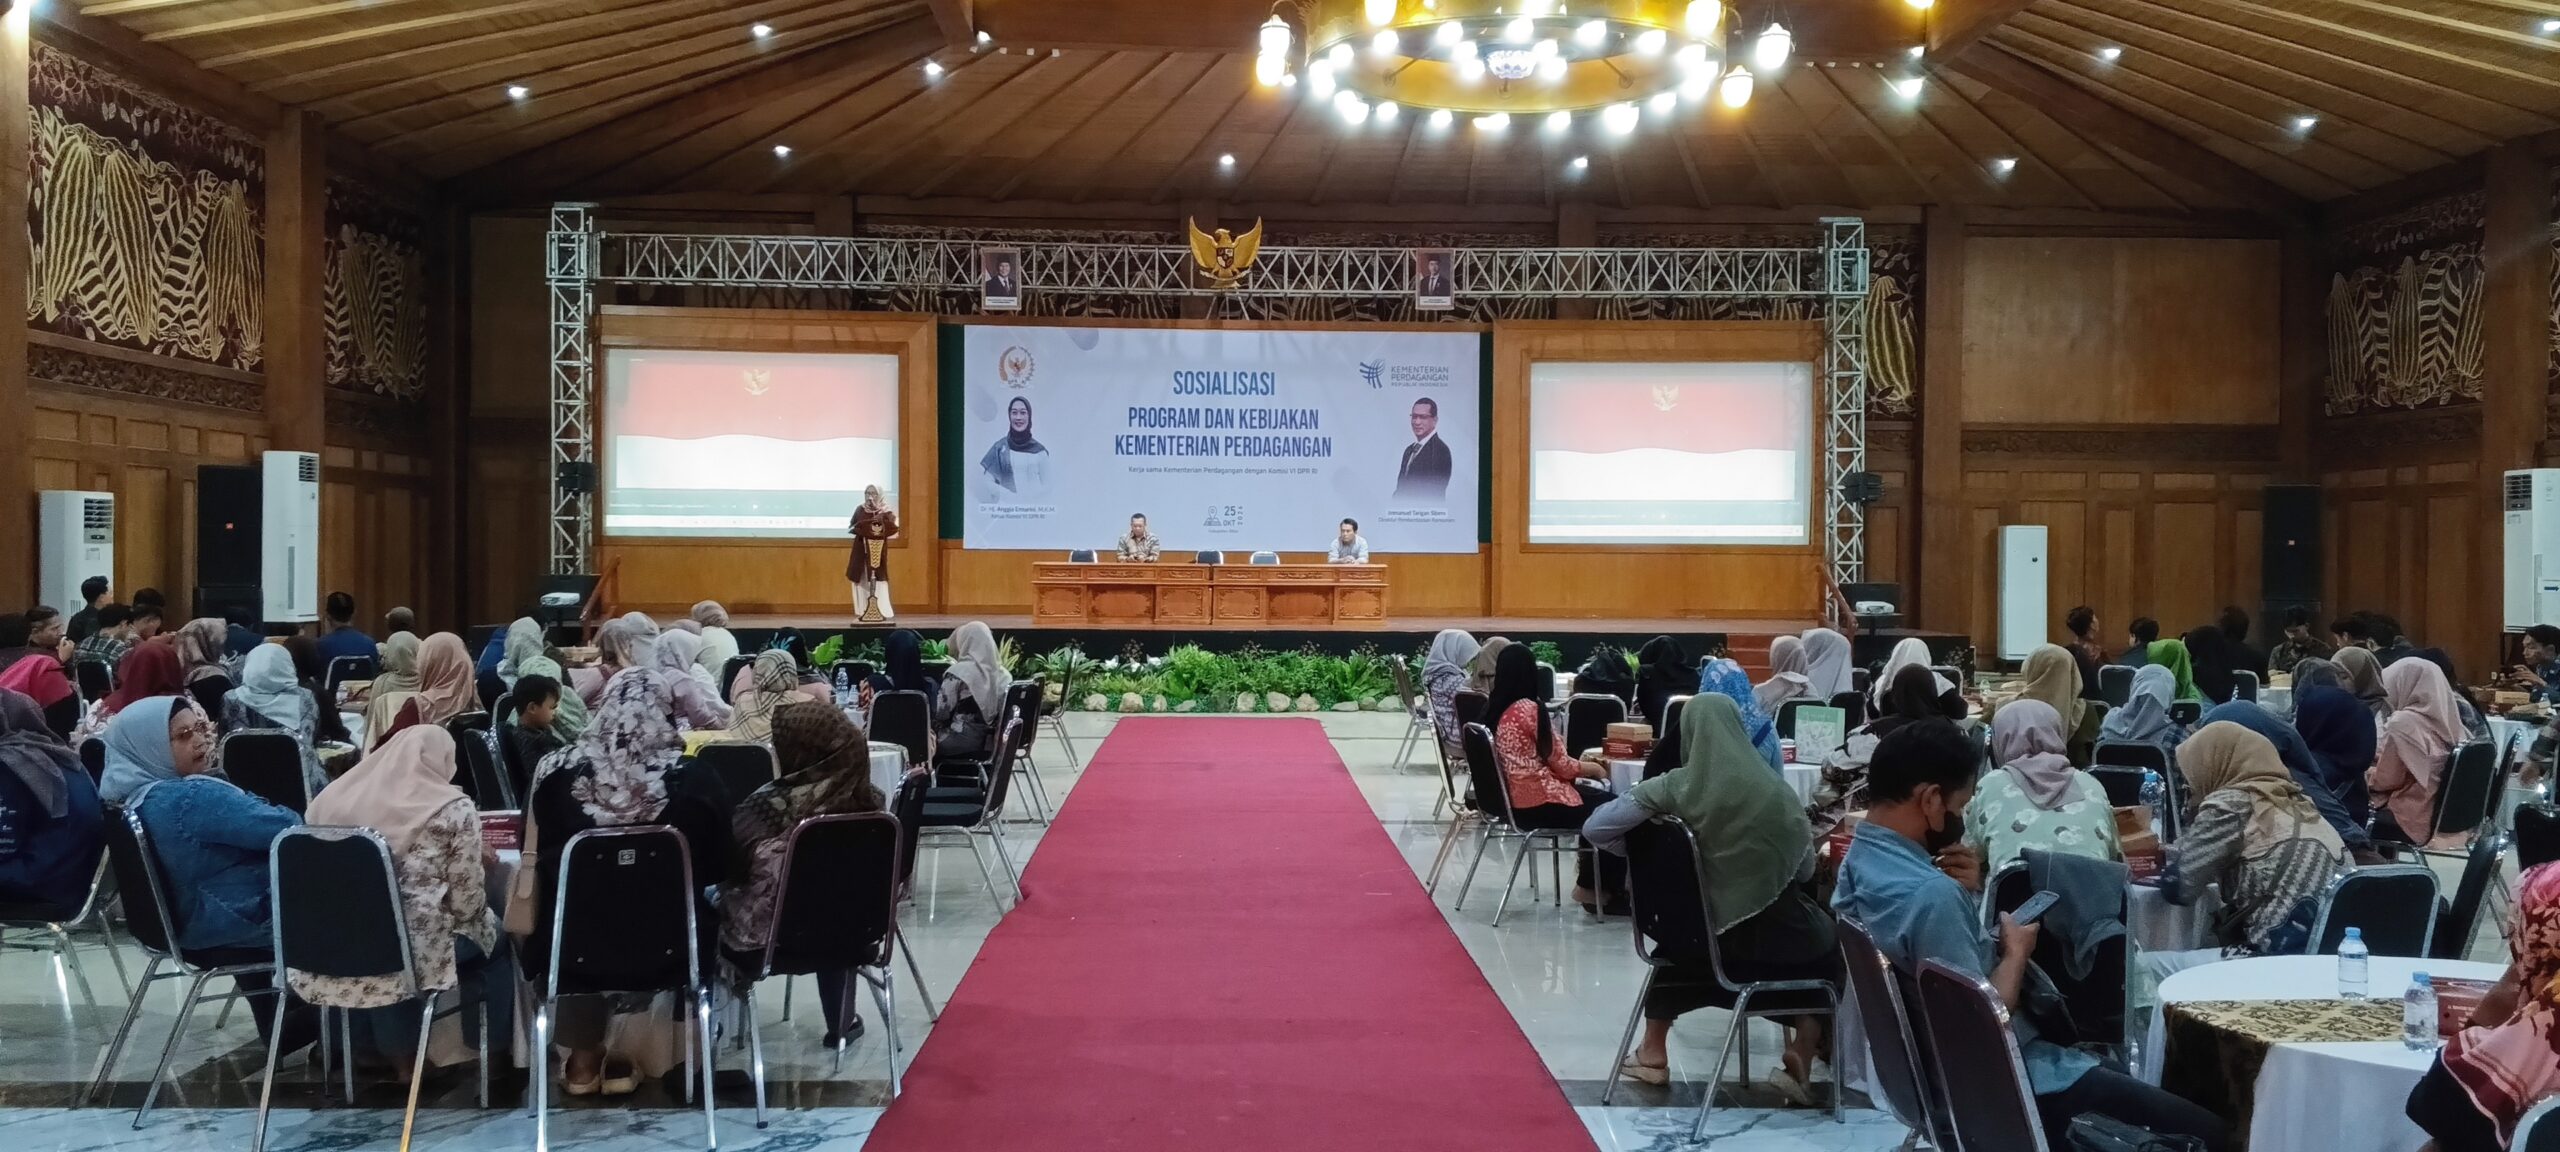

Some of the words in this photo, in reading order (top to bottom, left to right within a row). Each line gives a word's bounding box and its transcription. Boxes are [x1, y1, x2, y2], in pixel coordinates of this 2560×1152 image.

[1391, 365, 1449, 374] KEMENTERIAN
[1173, 370, 1275, 396] SOSIALISASI
[1391, 373, 1449, 382] PERDAGANGAN
[1128, 407, 1200, 429] PROGRAM
[1204, 408, 1235, 430] DAN
[1239, 408, 1319, 431] KEBIJAKAN
[1115, 434, 1220, 457] KEMENTERIAN
[1224, 436, 1332, 458] PERDAGANGAN
[1128, 466, 1145, 474] Kerja
[1203, 467, 1243, 475] Perdagangan
[1224, 505, 1236, 517] 25
